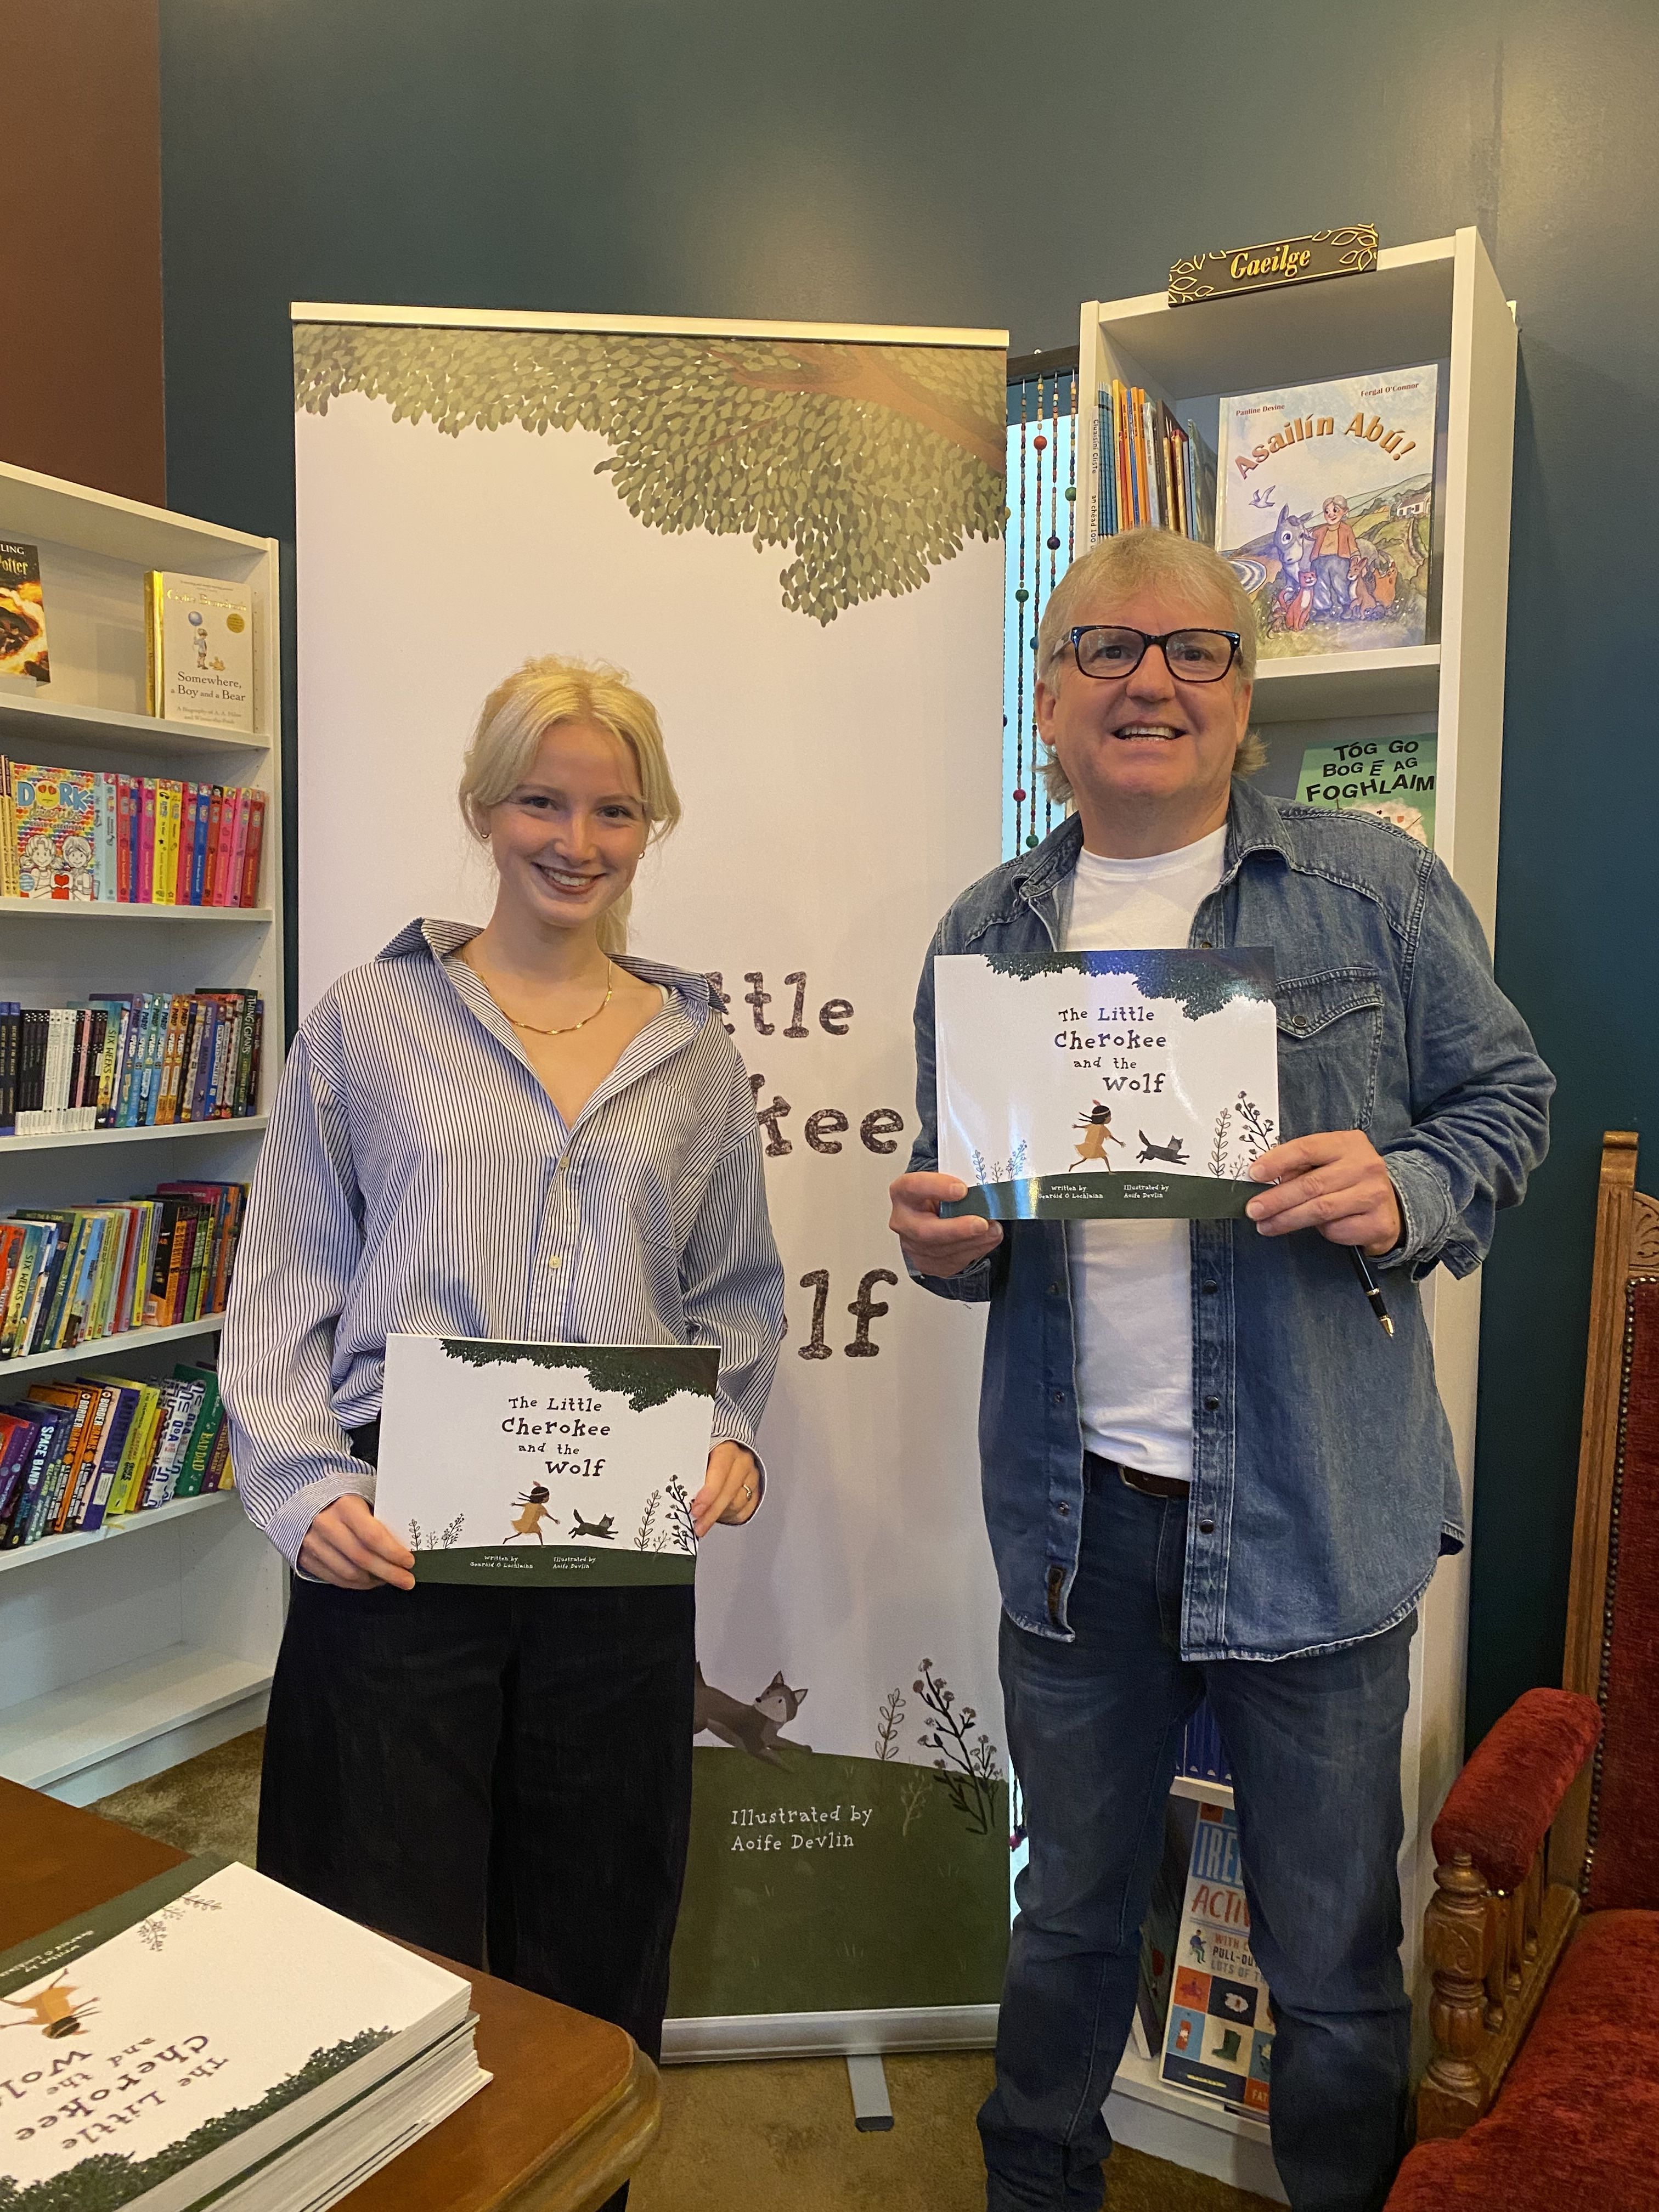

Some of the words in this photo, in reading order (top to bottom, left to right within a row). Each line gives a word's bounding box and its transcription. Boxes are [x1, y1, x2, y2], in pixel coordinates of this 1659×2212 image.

[1230, 245, 1311, 279] Gaeilge
[1361, 388, 1383, 397] Fergal
[1385, 383, 1419, 393] O'Connor
[1236, 407, 1261, 416] Pauline
[1262, 404, 1285, 413] Devine
[1235, 413, 1334, 480] Asailín
[1344, 412, 1416, 461] Abú!
[1091, 495, 1096, 503] an
[178, 671, 242, 689] Somewhere,
[178, 685, 199, 698] Boy
[222, 690, 246, 702] Bear
[1334, 742, 1378, 761] TÓG
[1389, 740, 1419, 753] GO
[1323, 761, 1364, 777] BOG
[1393, 757, 1418, 772] AG
[1306, 774, 1435, 802] FOGHLAIM
[1058, 1008, 1088, 1022] The
[1097, 1006, 1154, 1022] Little
[108, 1030, 116, 1046] SIX
[1054, 1029, 1166, 1049] Cherokee
[104, 1048, 114, 1074] WEEKS
[1074, 1057, 1102, 1068] and
[1113, 1057, 1137, 1069] the
[1103, 1073, 1166, 1093] Wolf
[23, 1255, 33, 1269] SIX
[15, 1273, 29, 1300] WEEKS
[782, 1268, 898, 1360] lf
[509, 1396, 538, 1409] The
[546, 1398, 602, 1412] Little
[501, 1417, 611, 1436] Cherokee
[35, 1426, 54, 1457] SPACE
[197, 1432, 215, 1451] BAD
[518, 1442, 546, 1452] and
[557, 1444, 580, 1454] the
[193, 1451, 207, 1471] DAD
[545, 1459, 606, 1477] Wolf
[27, 1459, 44, 1485] BAND
[731, 1805, 841, 1826] Illustrated
[850, 1805, 873, 1827] by
[731, 1834, 782, 1852] Aoife
[791, 1831, 854, 1850] Devlin
[1215, 1933, 1239, 1949] WITH
[1212, 1946, 1257, 1968] PULL-OU
[1211, 1960, 1234, 1975] LOTS
[1238, 1967, 1250, 1978] OF
[106, 2037, 156, 2068] and
[0, 2050, 93, 2108] Wol
[177, 2057, 229, 2087] The
[15, 2035, 209, 2141] Cherokee
[46, 2072, 93, 2095] the
[61, 2090, 167, 2149] Little
